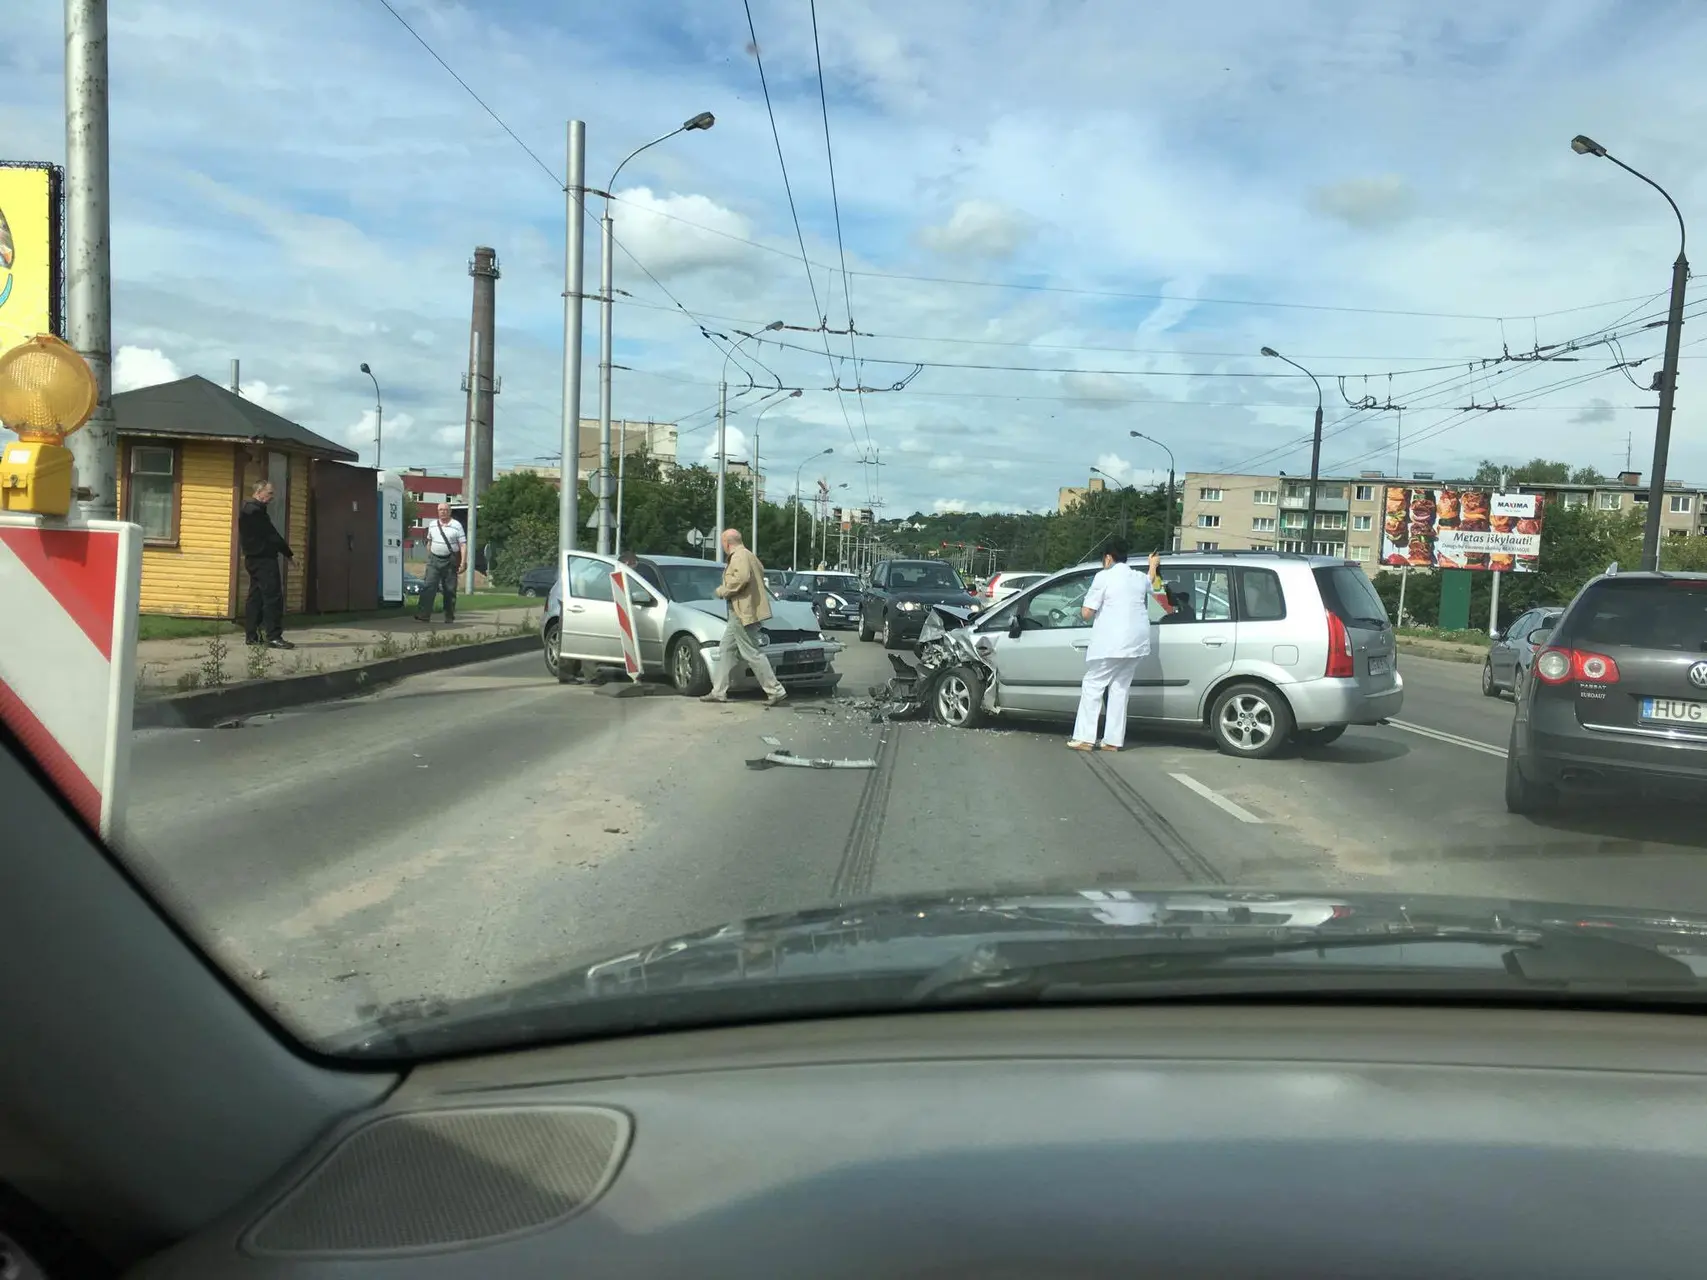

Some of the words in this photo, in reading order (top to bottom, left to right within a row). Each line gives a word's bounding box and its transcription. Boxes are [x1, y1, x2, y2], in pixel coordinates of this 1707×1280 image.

[1453, 532, 1484, 543] Metas
[1487, 533, 1532, 546] iškylauti!
[1655, 700, 1702, 720] HUG
